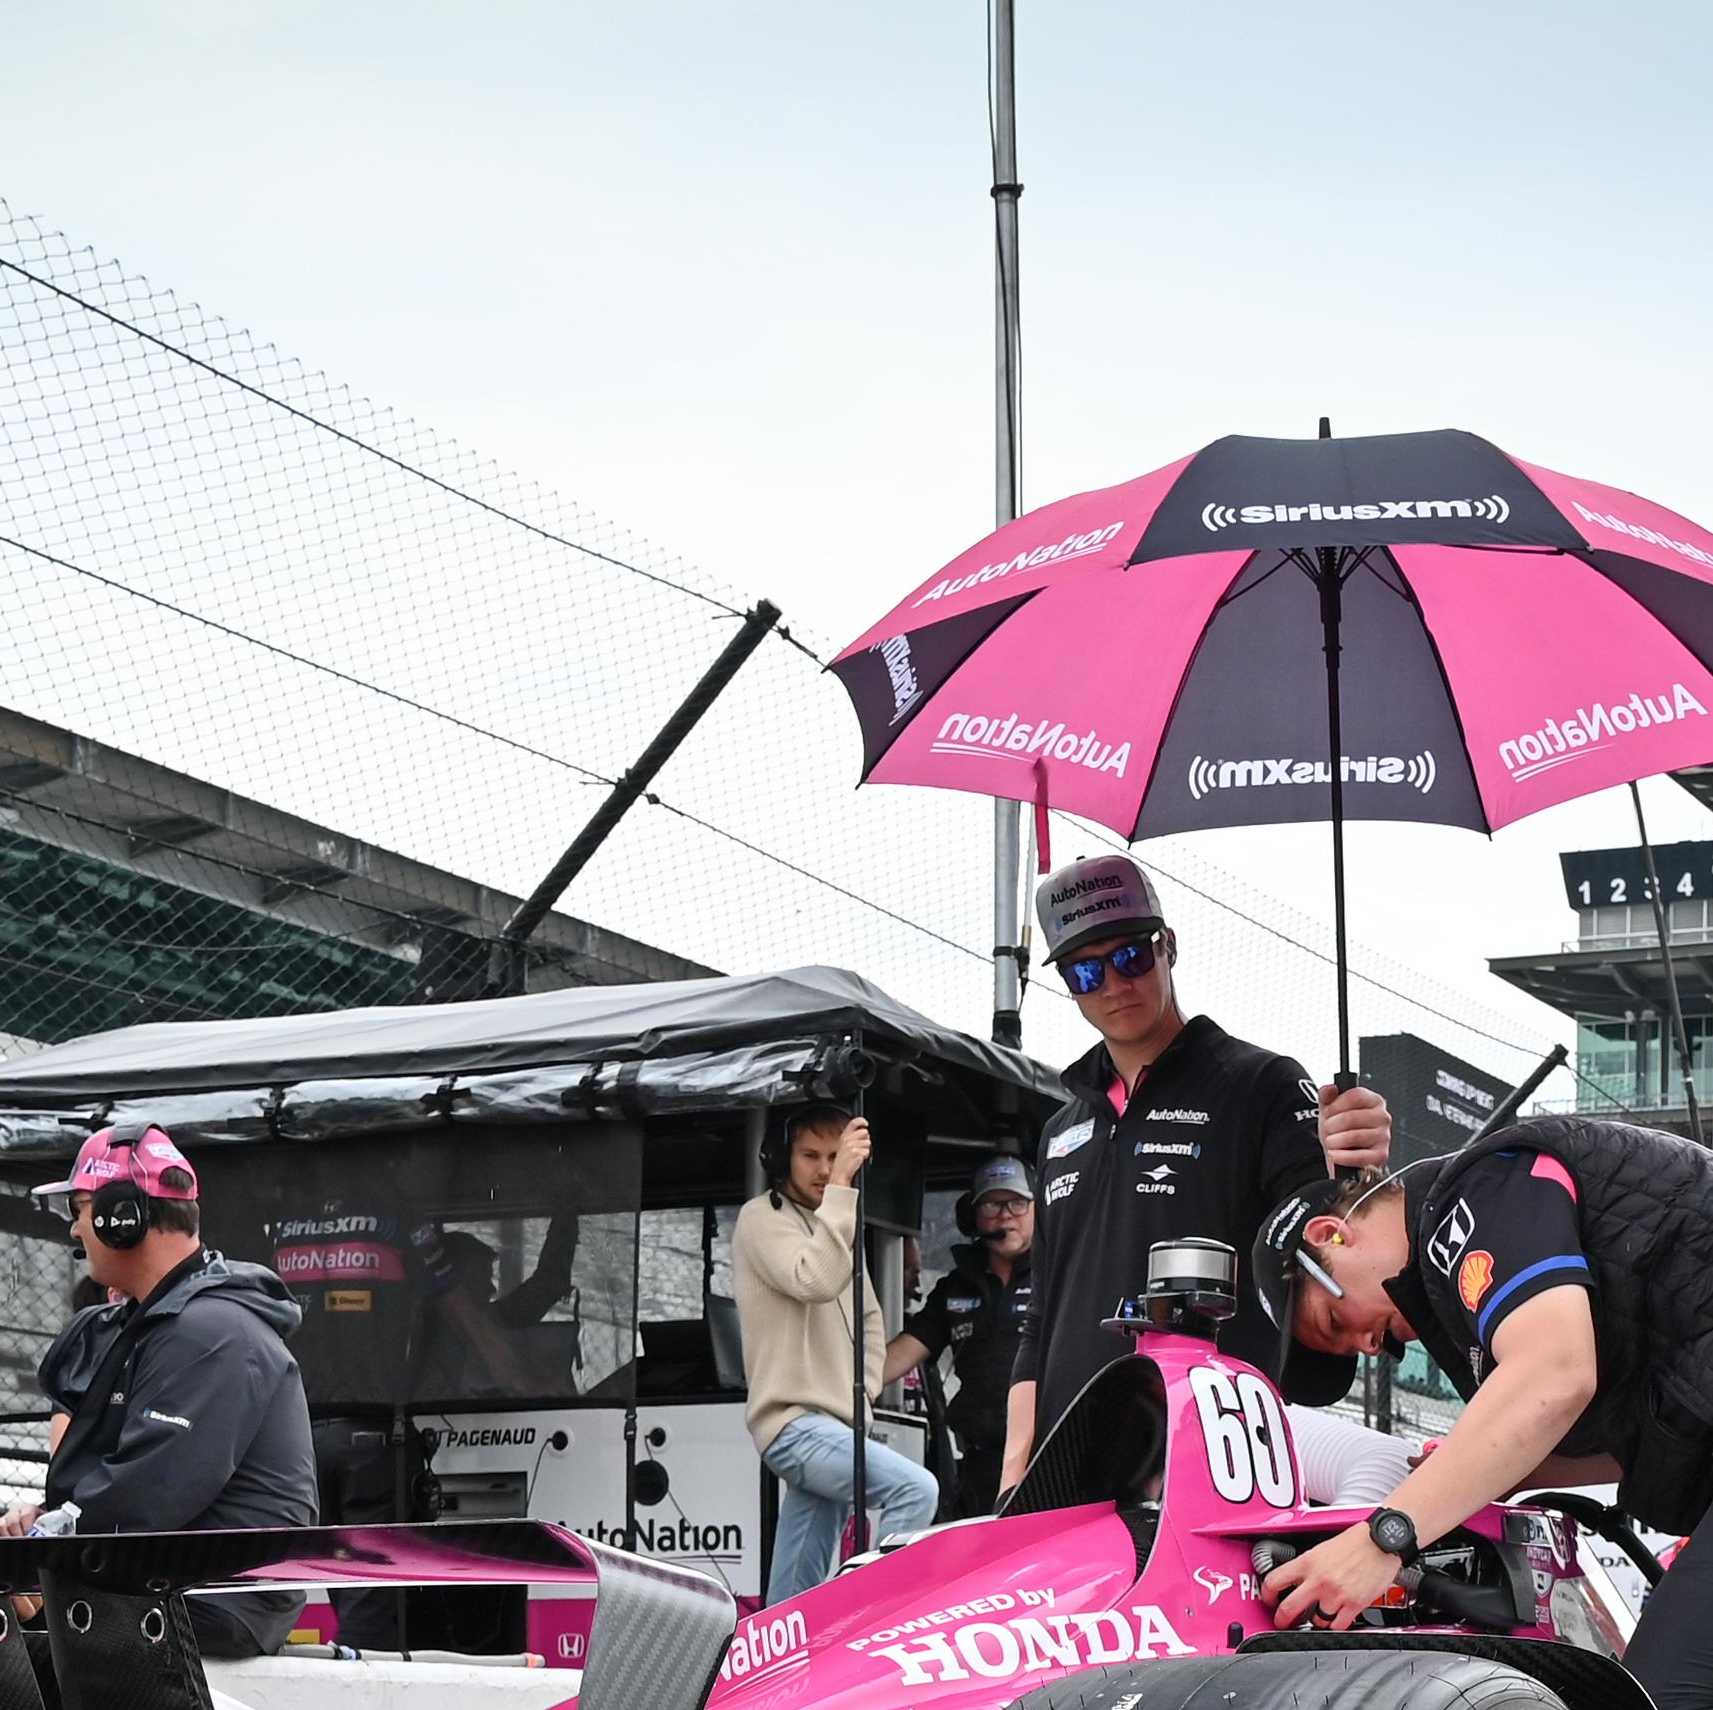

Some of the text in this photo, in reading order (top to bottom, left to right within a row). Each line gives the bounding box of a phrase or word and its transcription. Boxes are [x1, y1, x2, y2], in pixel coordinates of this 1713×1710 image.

[910, 521, 1124, 608] AutoNation
[1049, 873, 1124, 908] AutoNation
[1610, 878, 1628, 903] 2
[1676, 873, 1695, 897] 4
[1145, 1108, 1210, 1122] AutoNation
[1135, 1184, 1176, 1196] CLIFFS
[446, 1427, 537, 1448] PAGENAUD
[1187, 1365, 1297, 1509] 60
[845, 1587, 1058, 1652] POWERED by
[717, 1609, 808, 1683] Nation
[868, 1603, 1199, 1688] HONDA
